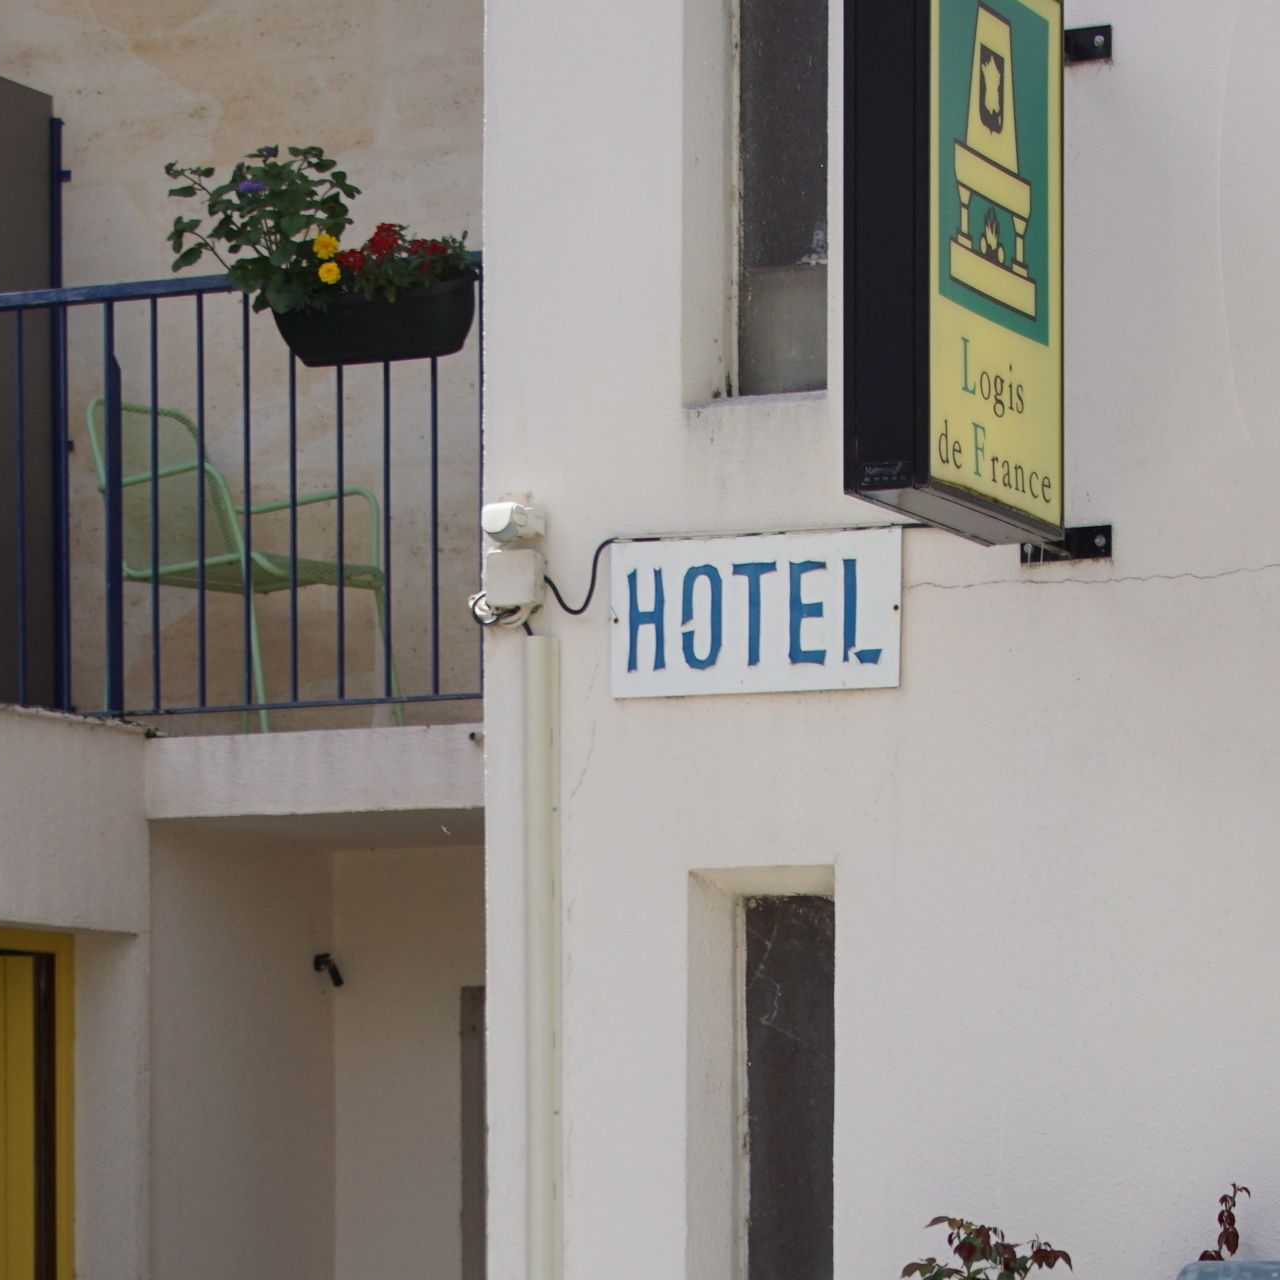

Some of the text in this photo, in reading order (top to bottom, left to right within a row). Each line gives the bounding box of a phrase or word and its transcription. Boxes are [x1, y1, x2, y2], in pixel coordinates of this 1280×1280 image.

[961, 336, 1024, 417] Logis
[938, 418, 1052, 503] de France
[627, 559, 883, 673] HOTEL
